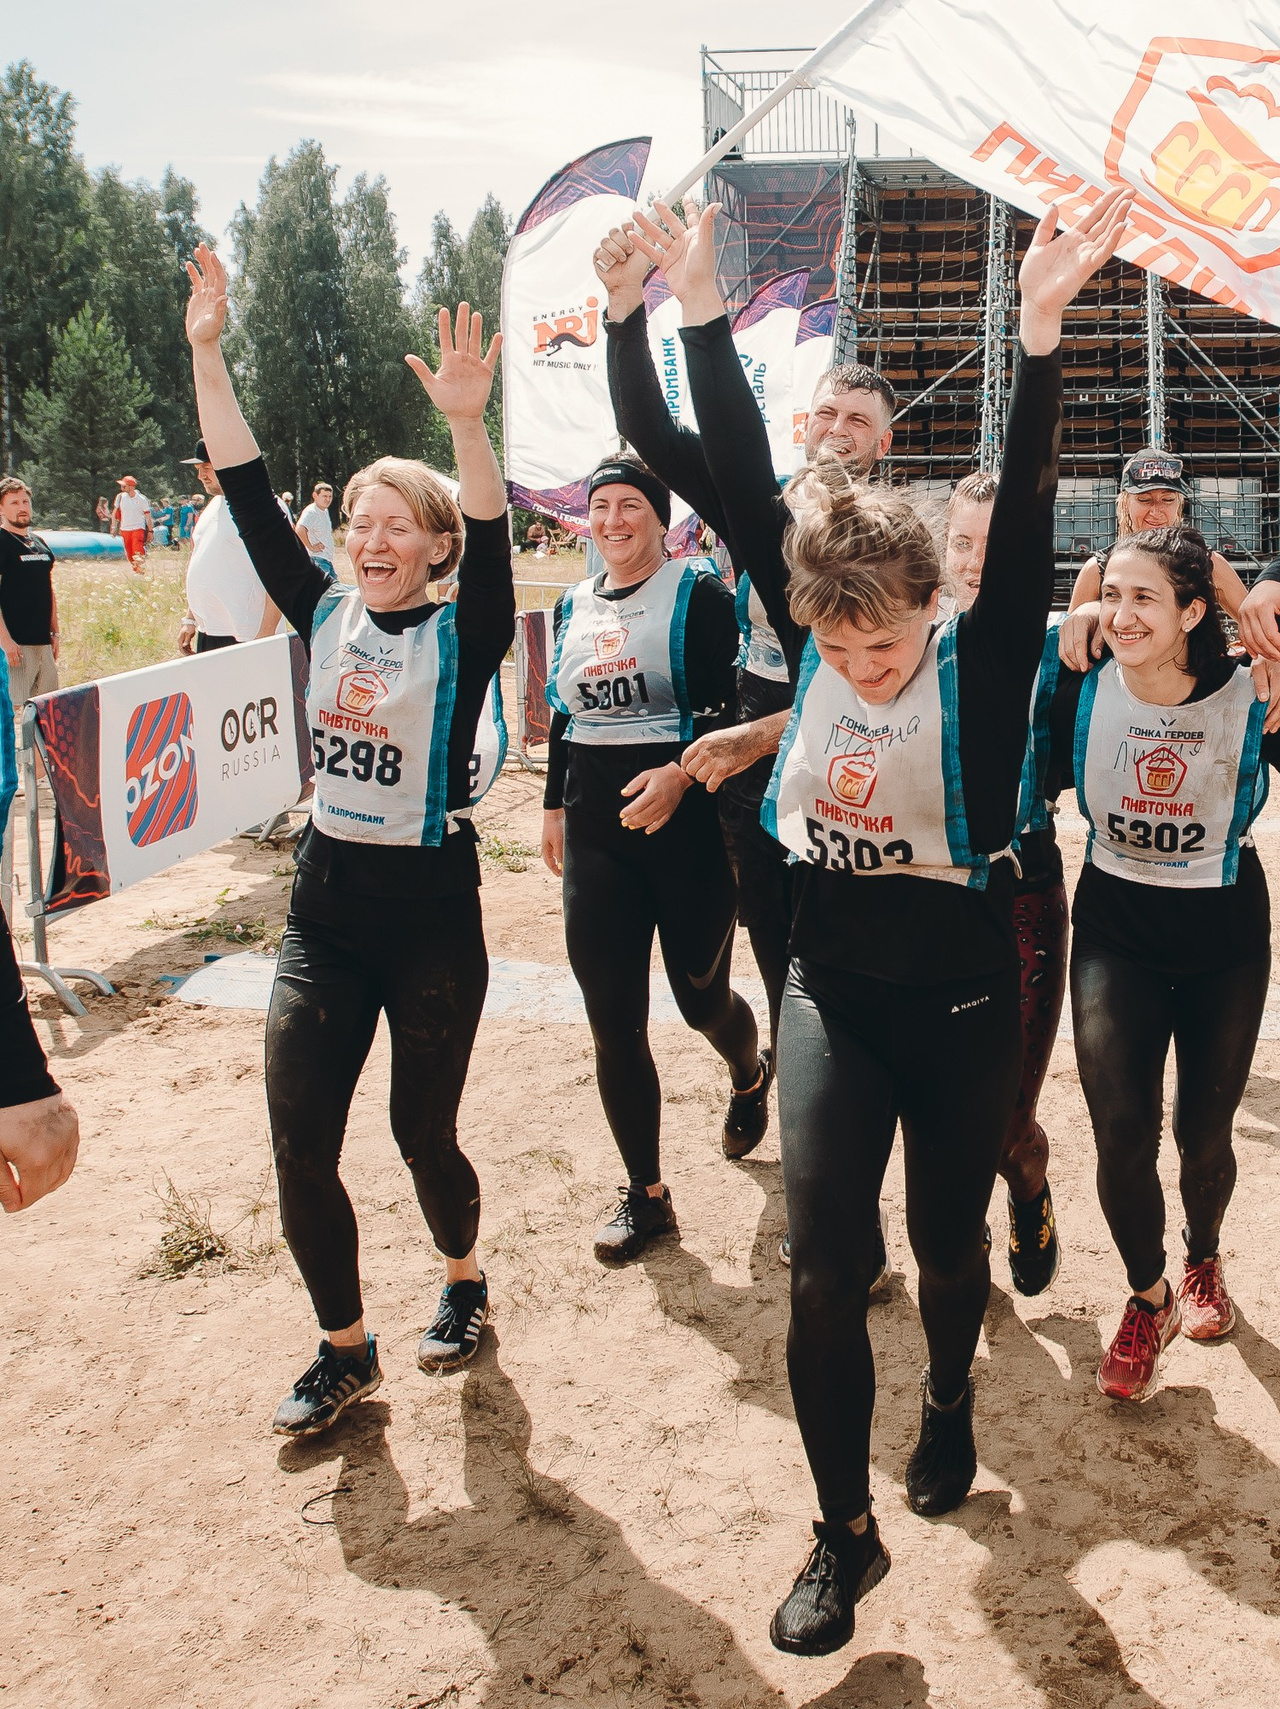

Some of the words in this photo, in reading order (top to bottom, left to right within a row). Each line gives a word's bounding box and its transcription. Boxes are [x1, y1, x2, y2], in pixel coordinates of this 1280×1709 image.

[533, 306, 583, 322] ENERGY
[547, 361, 571, 369] MUSIC
[573, 362, 592, 371] ONLY
[344, 643, 376, 663] ГОНКА
[583, 657, 638, 678] ПИВТОЧКА
[576, 672, 650, 711] 5301
[221, 697, 279, 752] OCR
[318, 709, 389, 740] ПИВТОЧКА
[1129, 726, 1161, 739] ГОНКА
[1165, 730, 1204, 740] ГЕРОЕВ
[221, 744, 281, 781] RUSSIA
[312, 727, 403, 787] 5298
[327, 804, 386, 825] ГАЗПРОМБАНК
[815, 798, 894, 833] ПИВТОЧКА
[1121, 795, 1194, 817] ПИВТОЧКА
[1107, 812, 1206, 853] 5302
